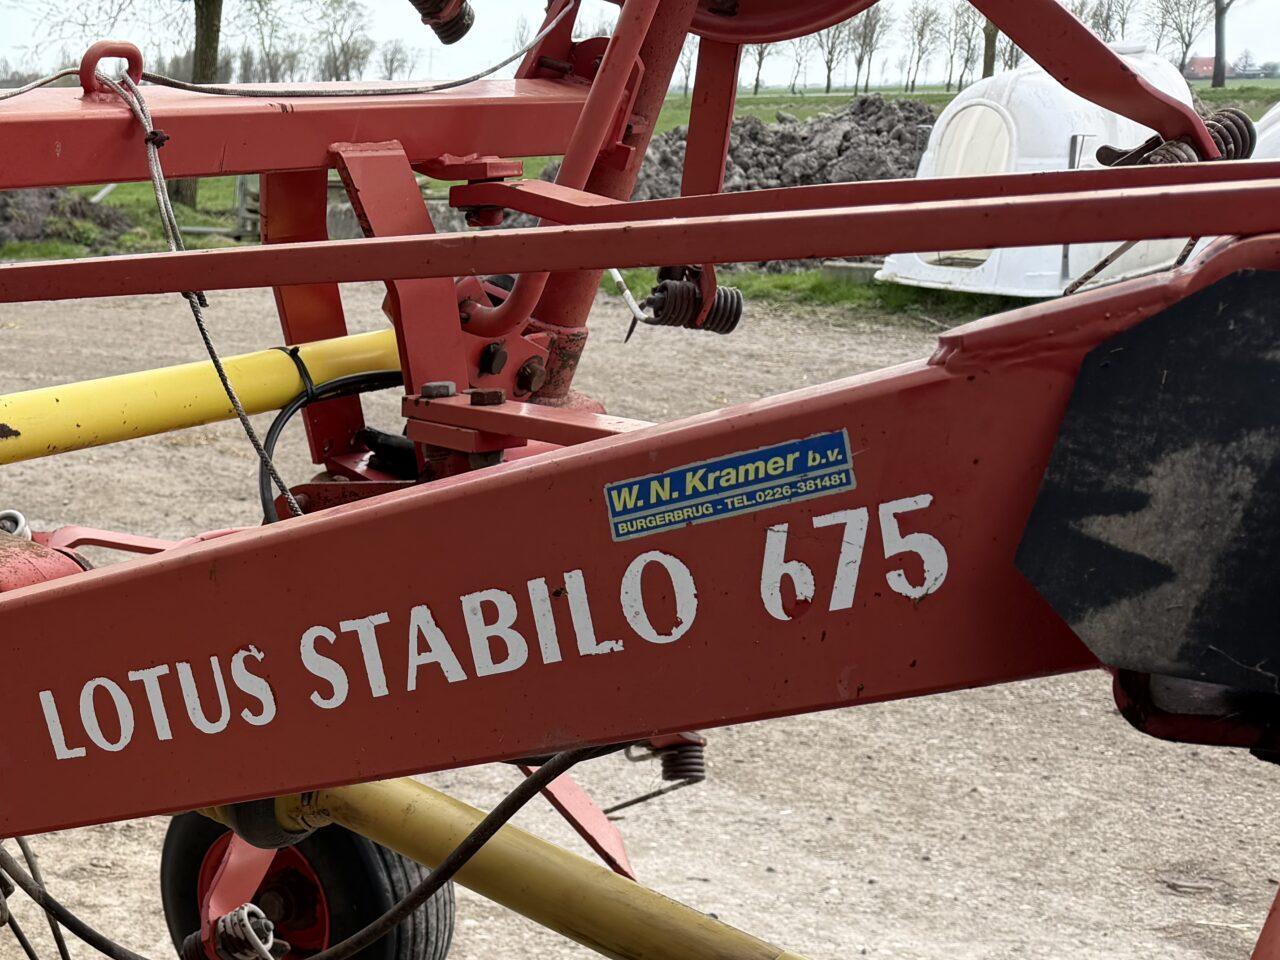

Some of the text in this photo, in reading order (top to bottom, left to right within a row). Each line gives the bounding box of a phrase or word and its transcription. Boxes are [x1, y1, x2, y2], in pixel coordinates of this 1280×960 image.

[610, 448, 843, 513] W. N. Kramer b.v.
[617, 503, 714, 534] BURGERBRUG
[39, 493, 949, 760] LOTUS STABILO 675
